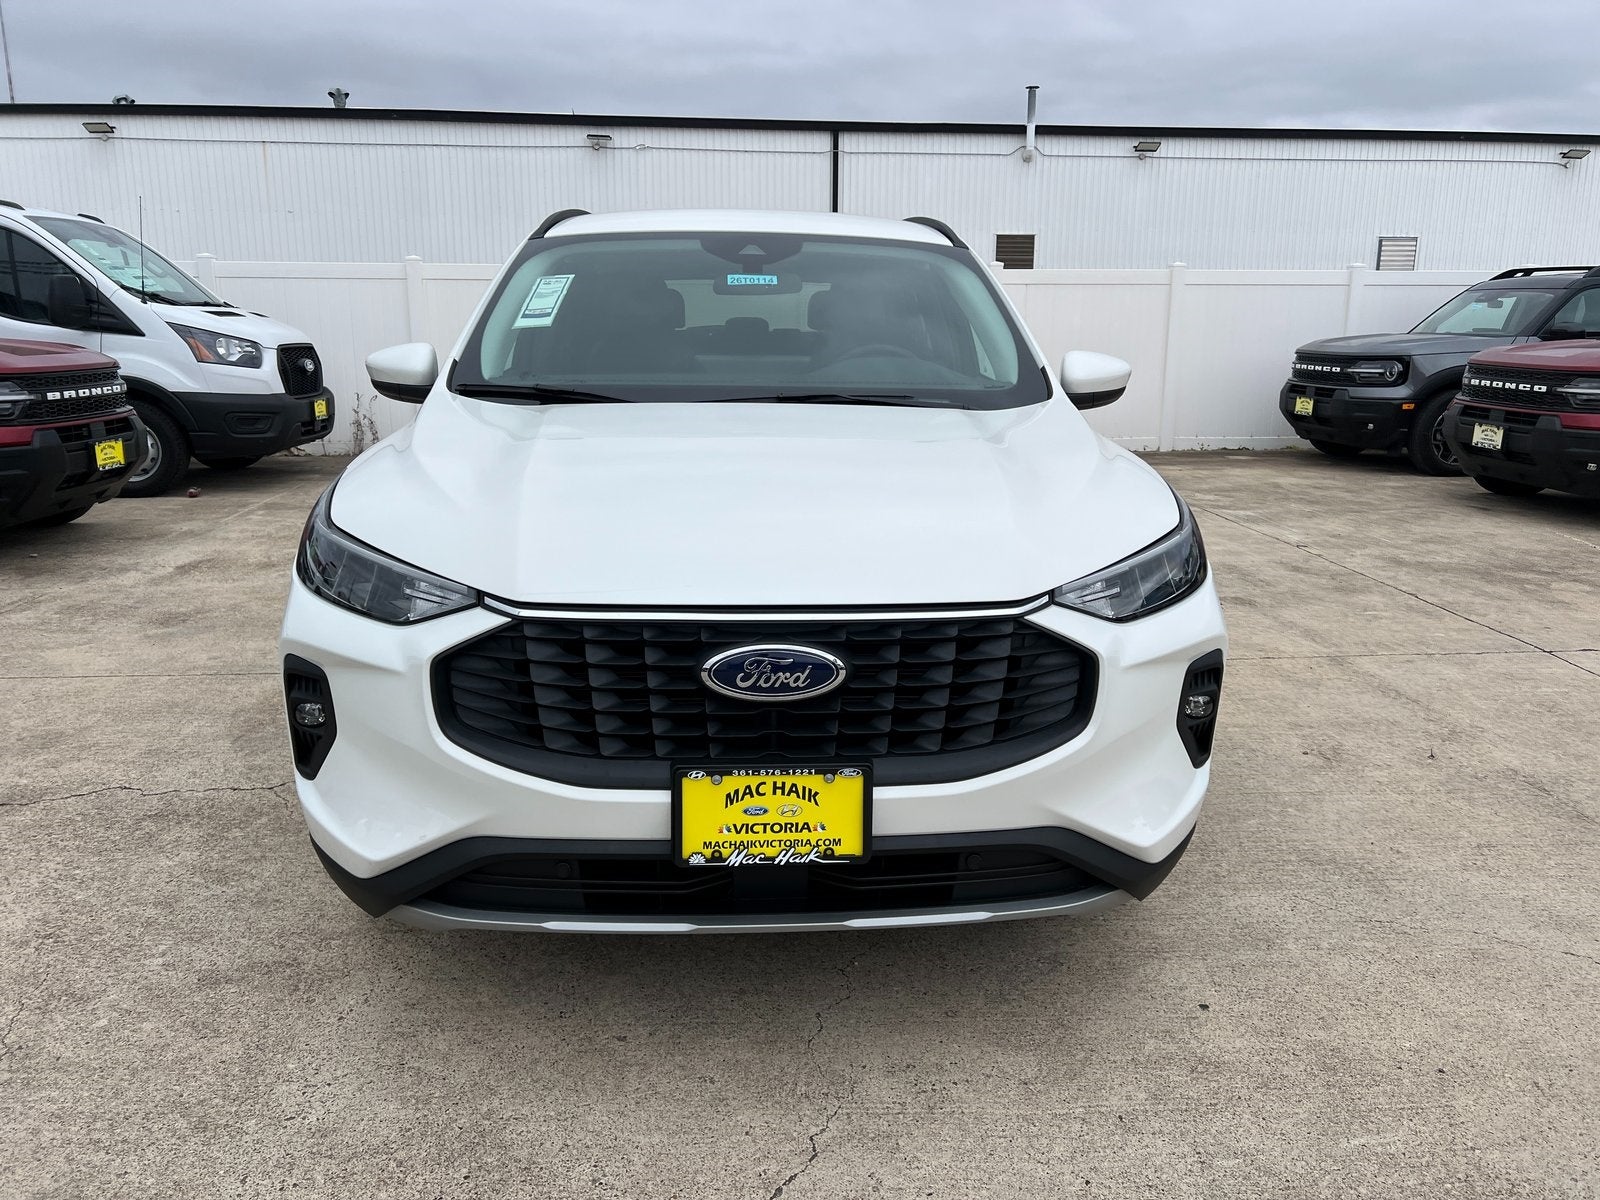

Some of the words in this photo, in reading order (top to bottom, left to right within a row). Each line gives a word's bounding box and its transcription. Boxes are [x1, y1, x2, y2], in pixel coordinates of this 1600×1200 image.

[729, 276, 775, 285] 26T0114
[1295, 363, 1341, 373] BRONCO
[46, 385, 121, 400] BRONCO
[1470, 378, 1547, 393] BRONCO
[735, 656, 813, 688] Ford
[732, 769, 816, 777] 361-576-1221
[725, 781, 767, 809] MAC
[772, 780, 820, 807] HAIK
[732, 822, 813, 835] VICTORIA
[702, 838, 842, 850] MACHAIKVICTORIA.COM
[724, 848, 771, 866] Mac
[773, 847, 832, 866] Haik
